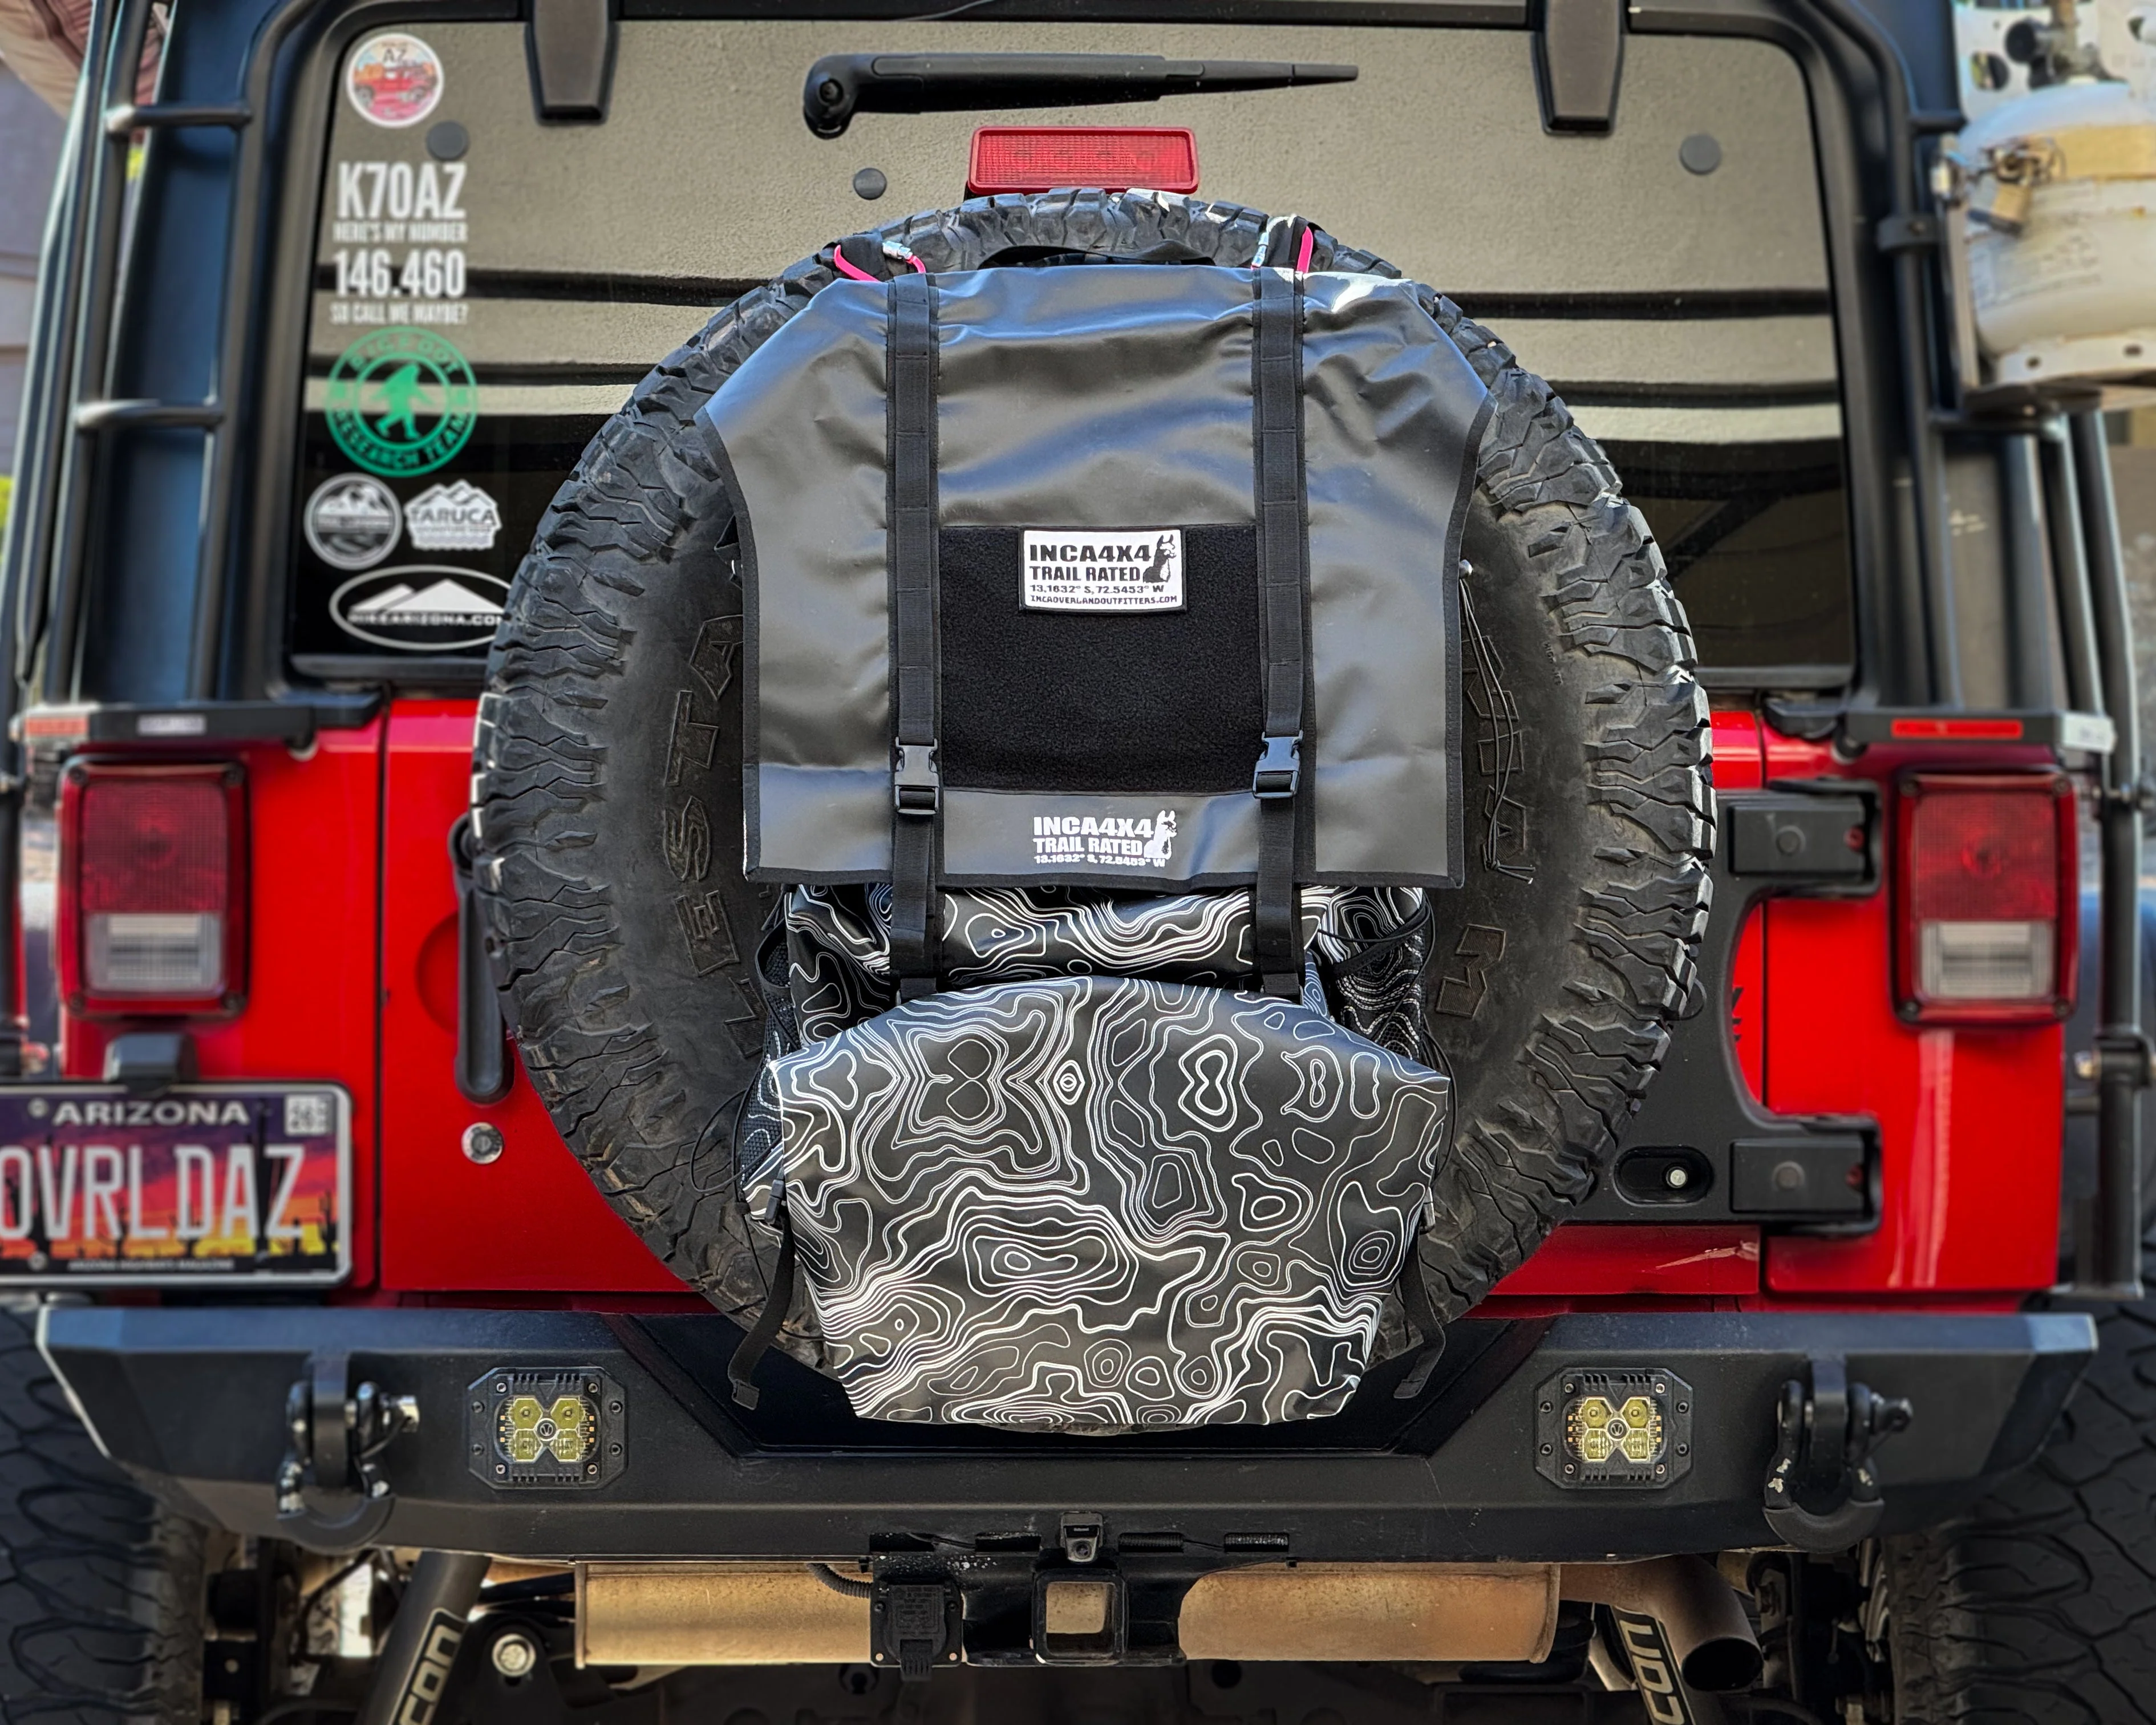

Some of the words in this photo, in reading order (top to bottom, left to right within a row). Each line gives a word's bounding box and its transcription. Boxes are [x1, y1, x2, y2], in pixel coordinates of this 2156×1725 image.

[333, 249, 467, 298] 146.460
[1030, 544, 1152, 562] INCA4X4
[1029, 566, 1081, 581] TRAIL
[1086, 566, 1141, 581] RATED
[1030, 595, 1177, 605] INCAOVERLANDOUTFITTERS.COM
[1034, 816, 1154, 838] INCA4X4
[1032, 836, 1084, 853] TRAIL
[1088, 837, 1143, 856] RATED
[1153, 858, 1166, 867] W
[52, 1101, 250, 1126] ARIZONA
[0, 1144, 305, 1239] OVRLDAZ
